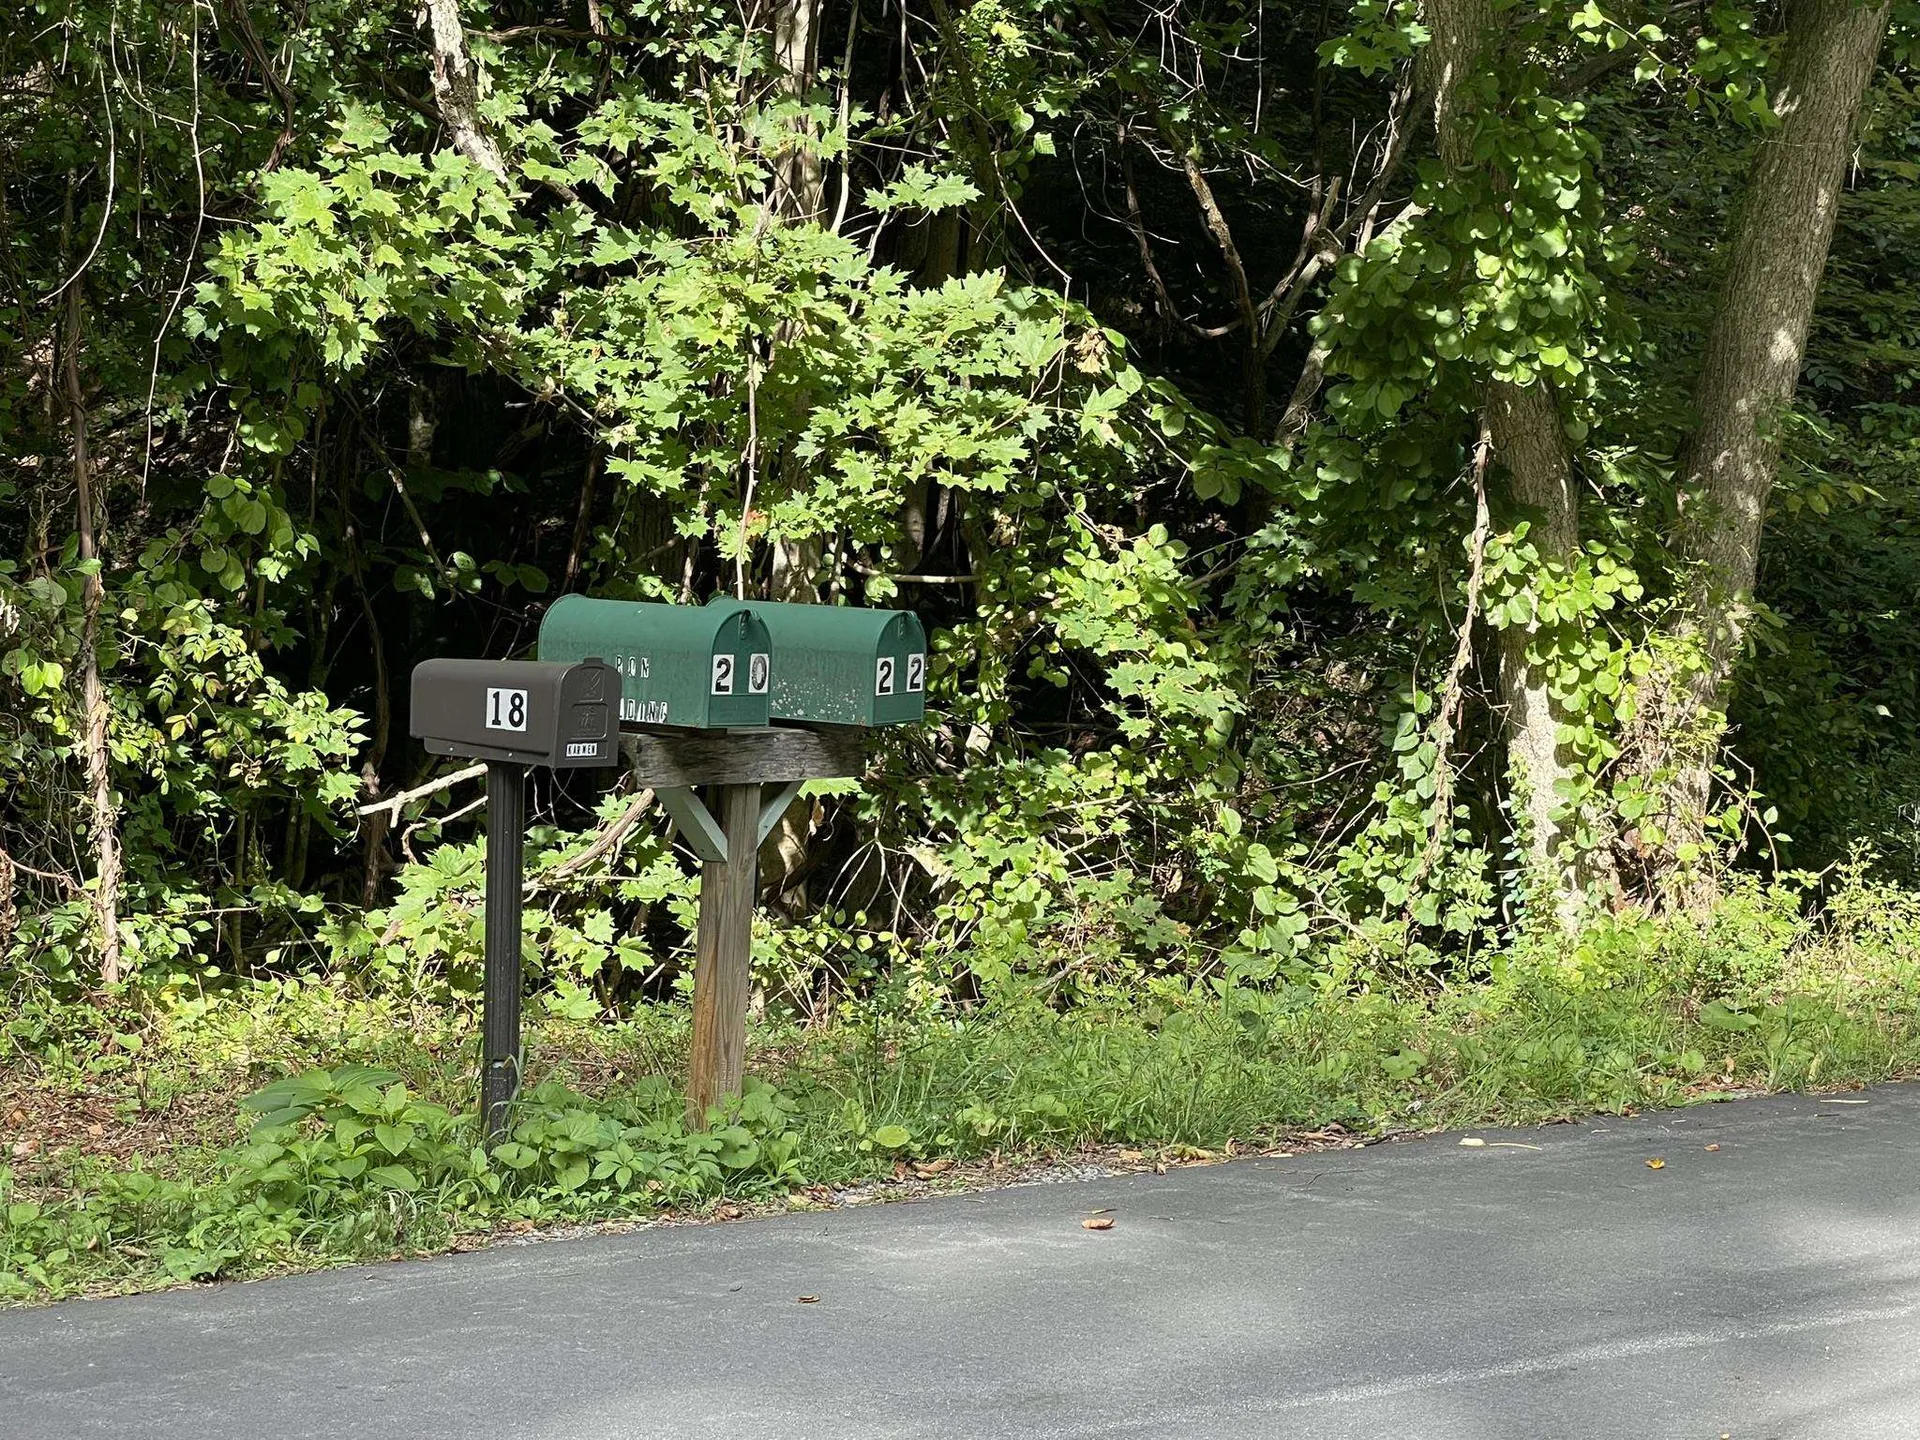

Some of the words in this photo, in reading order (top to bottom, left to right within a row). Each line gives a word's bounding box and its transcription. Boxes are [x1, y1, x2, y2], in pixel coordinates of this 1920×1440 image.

[715, 656, 767, 692] 20
[879, 657, 922, 693] 22
[492, 691, 524, 728] 18
[619, 698, 668, 723] DING
